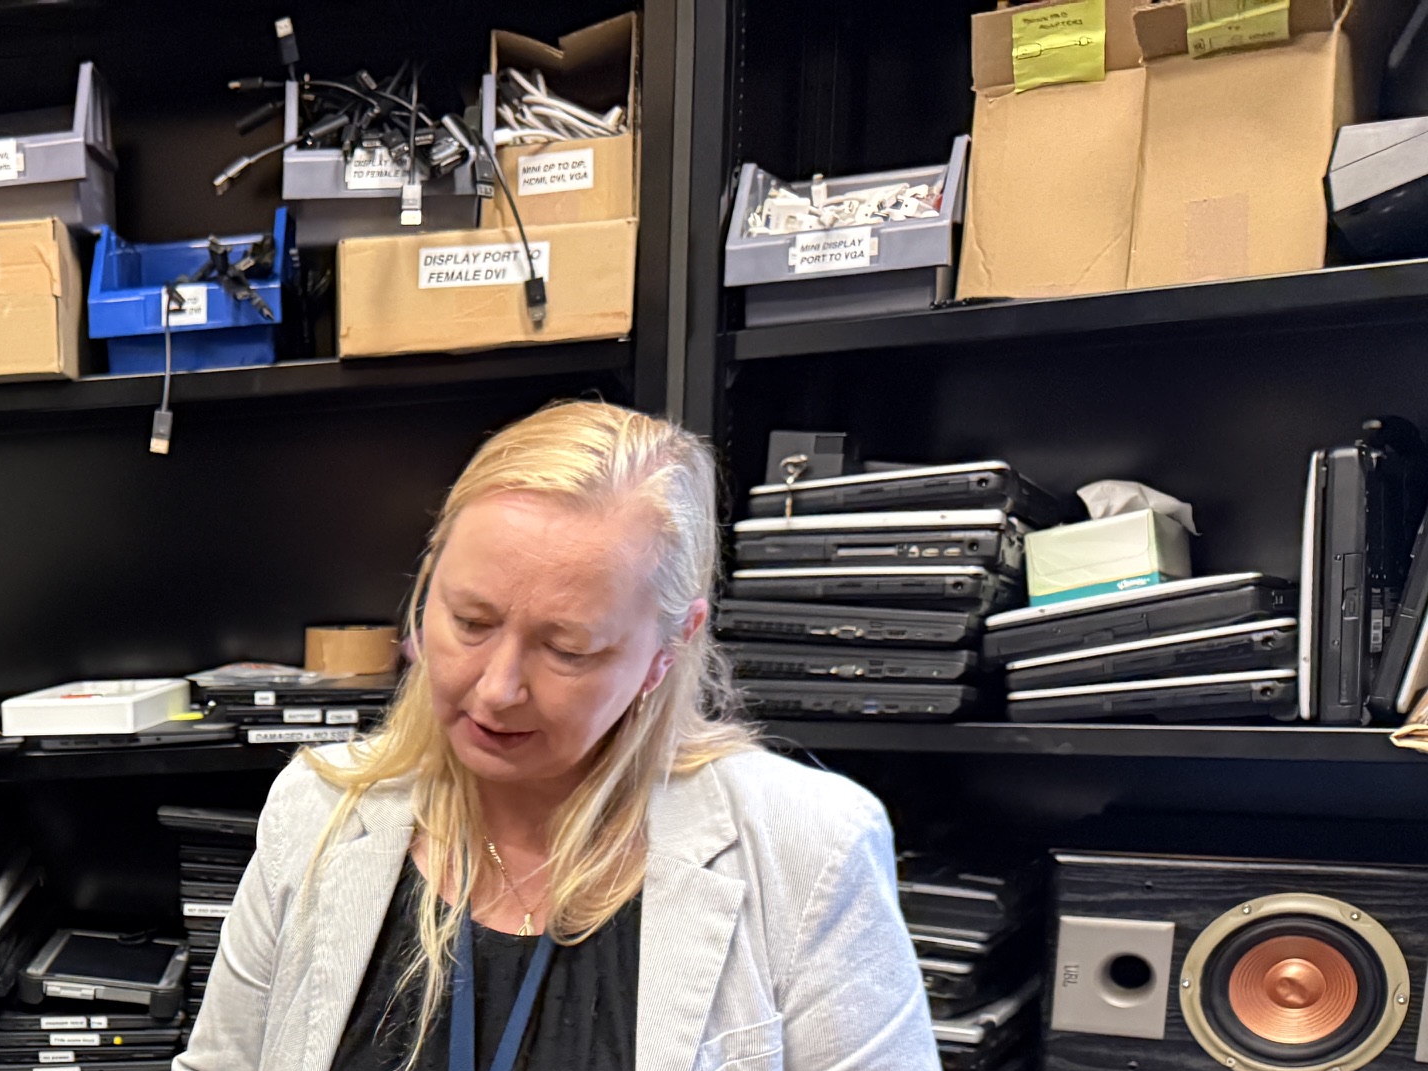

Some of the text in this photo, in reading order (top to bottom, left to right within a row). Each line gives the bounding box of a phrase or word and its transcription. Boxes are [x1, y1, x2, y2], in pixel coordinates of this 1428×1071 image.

[557, 162, 569, 170] TO
[353, 170, 364, 179] TO
[800, 238, 864, 253] MINI DISPLAY
[423, 251, 481, 267] DISPLAY
[482, 250, 520, 263] PORT
[800, 250, 864, 265] PORT TO VGA
[427, 268, 507, 284] FEMALE DVI
